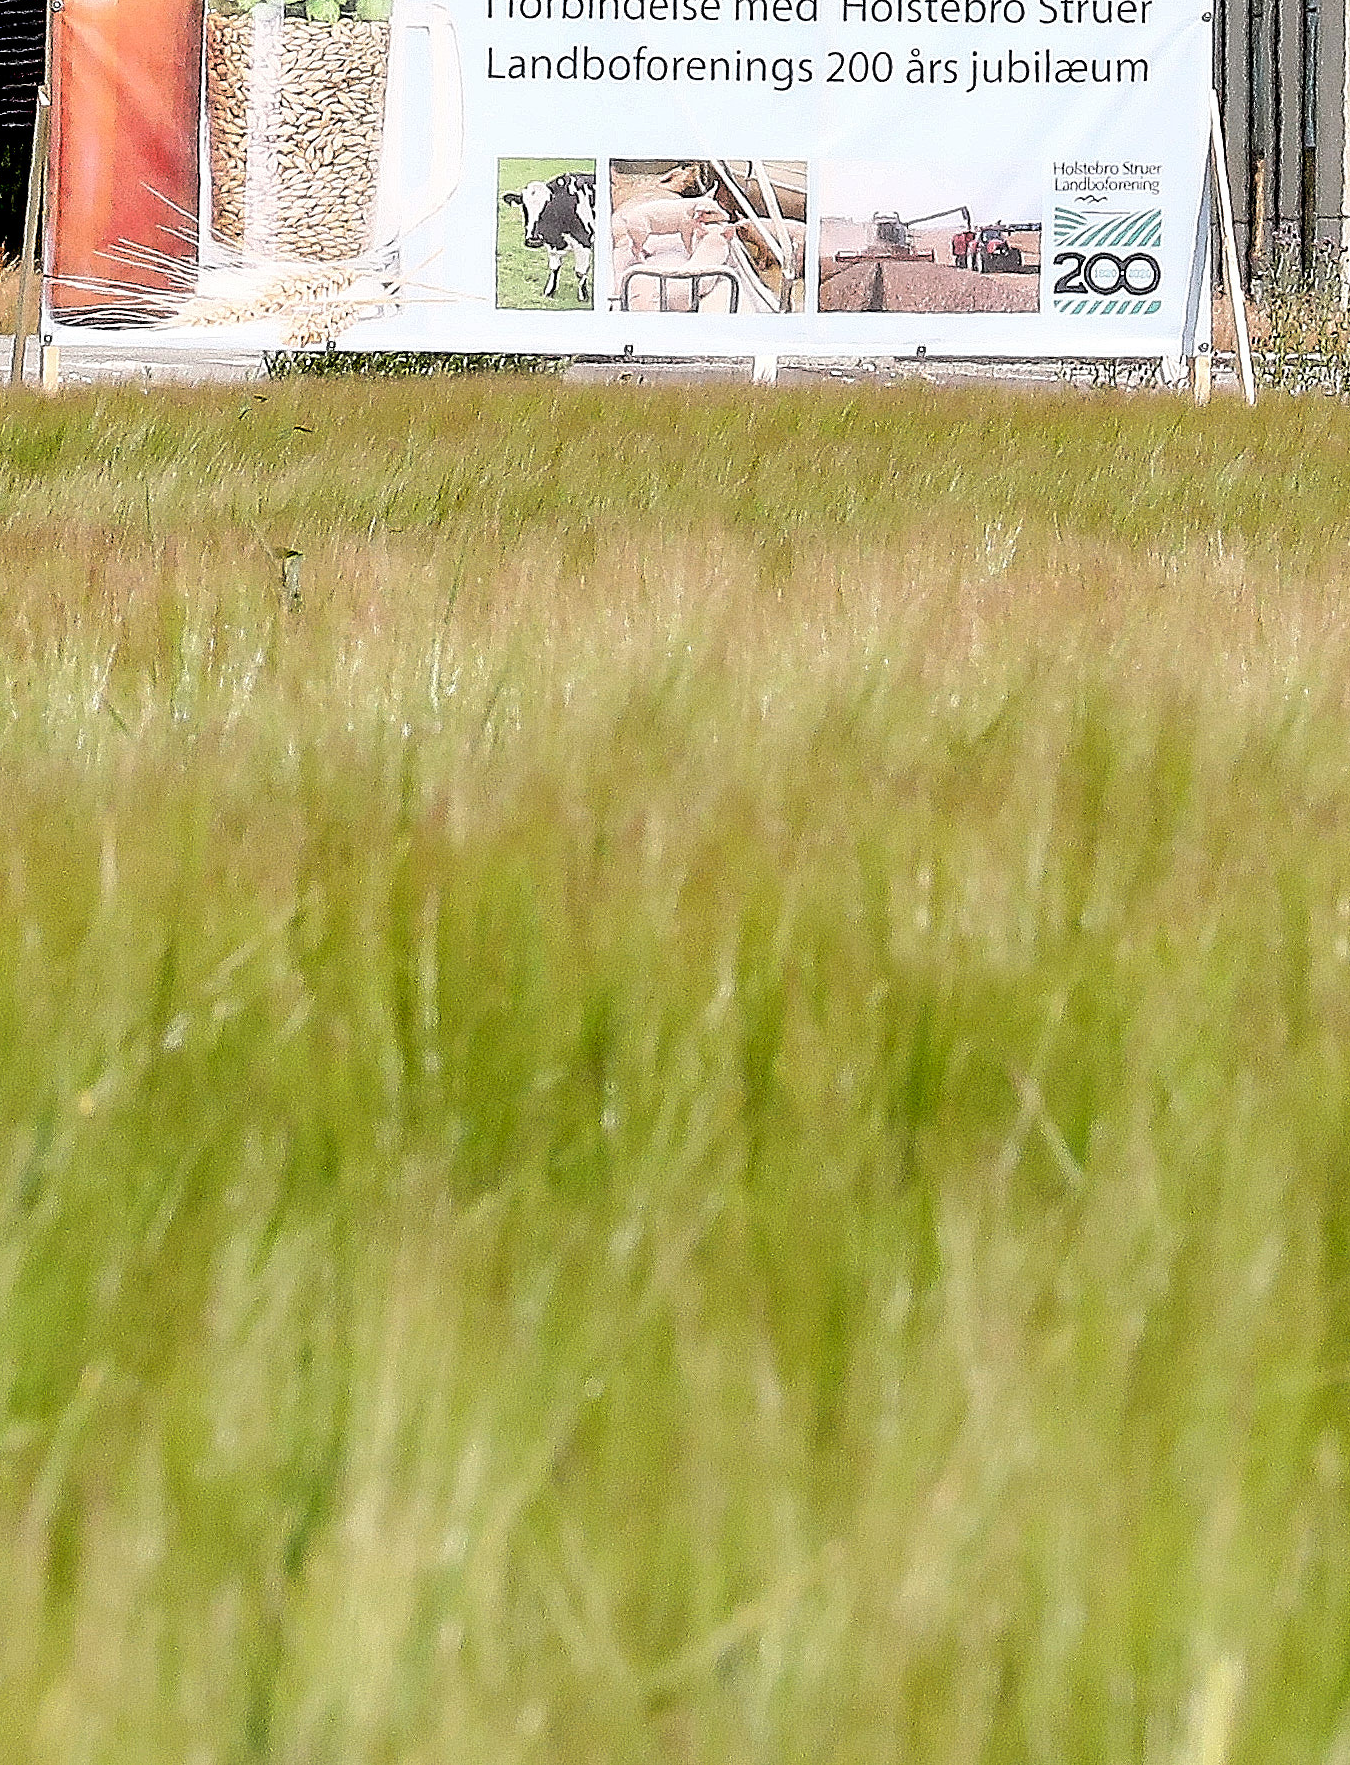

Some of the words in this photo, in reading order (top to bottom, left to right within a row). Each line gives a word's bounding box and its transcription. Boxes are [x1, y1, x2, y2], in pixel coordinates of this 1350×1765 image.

[487, 45, 813, 92] Landboforenings
[826, 51, 893, 83] 200
[905, 48, 958, 84] års
[966, 49, 1150, 93] jubilæum
[1053, 161, 1119, 176] Holstebro
[1123, 161, 1162, 176] Struer
[1054, 176, 1160, 195] Landboforening
[1053, 251, 1161, 296] 200
